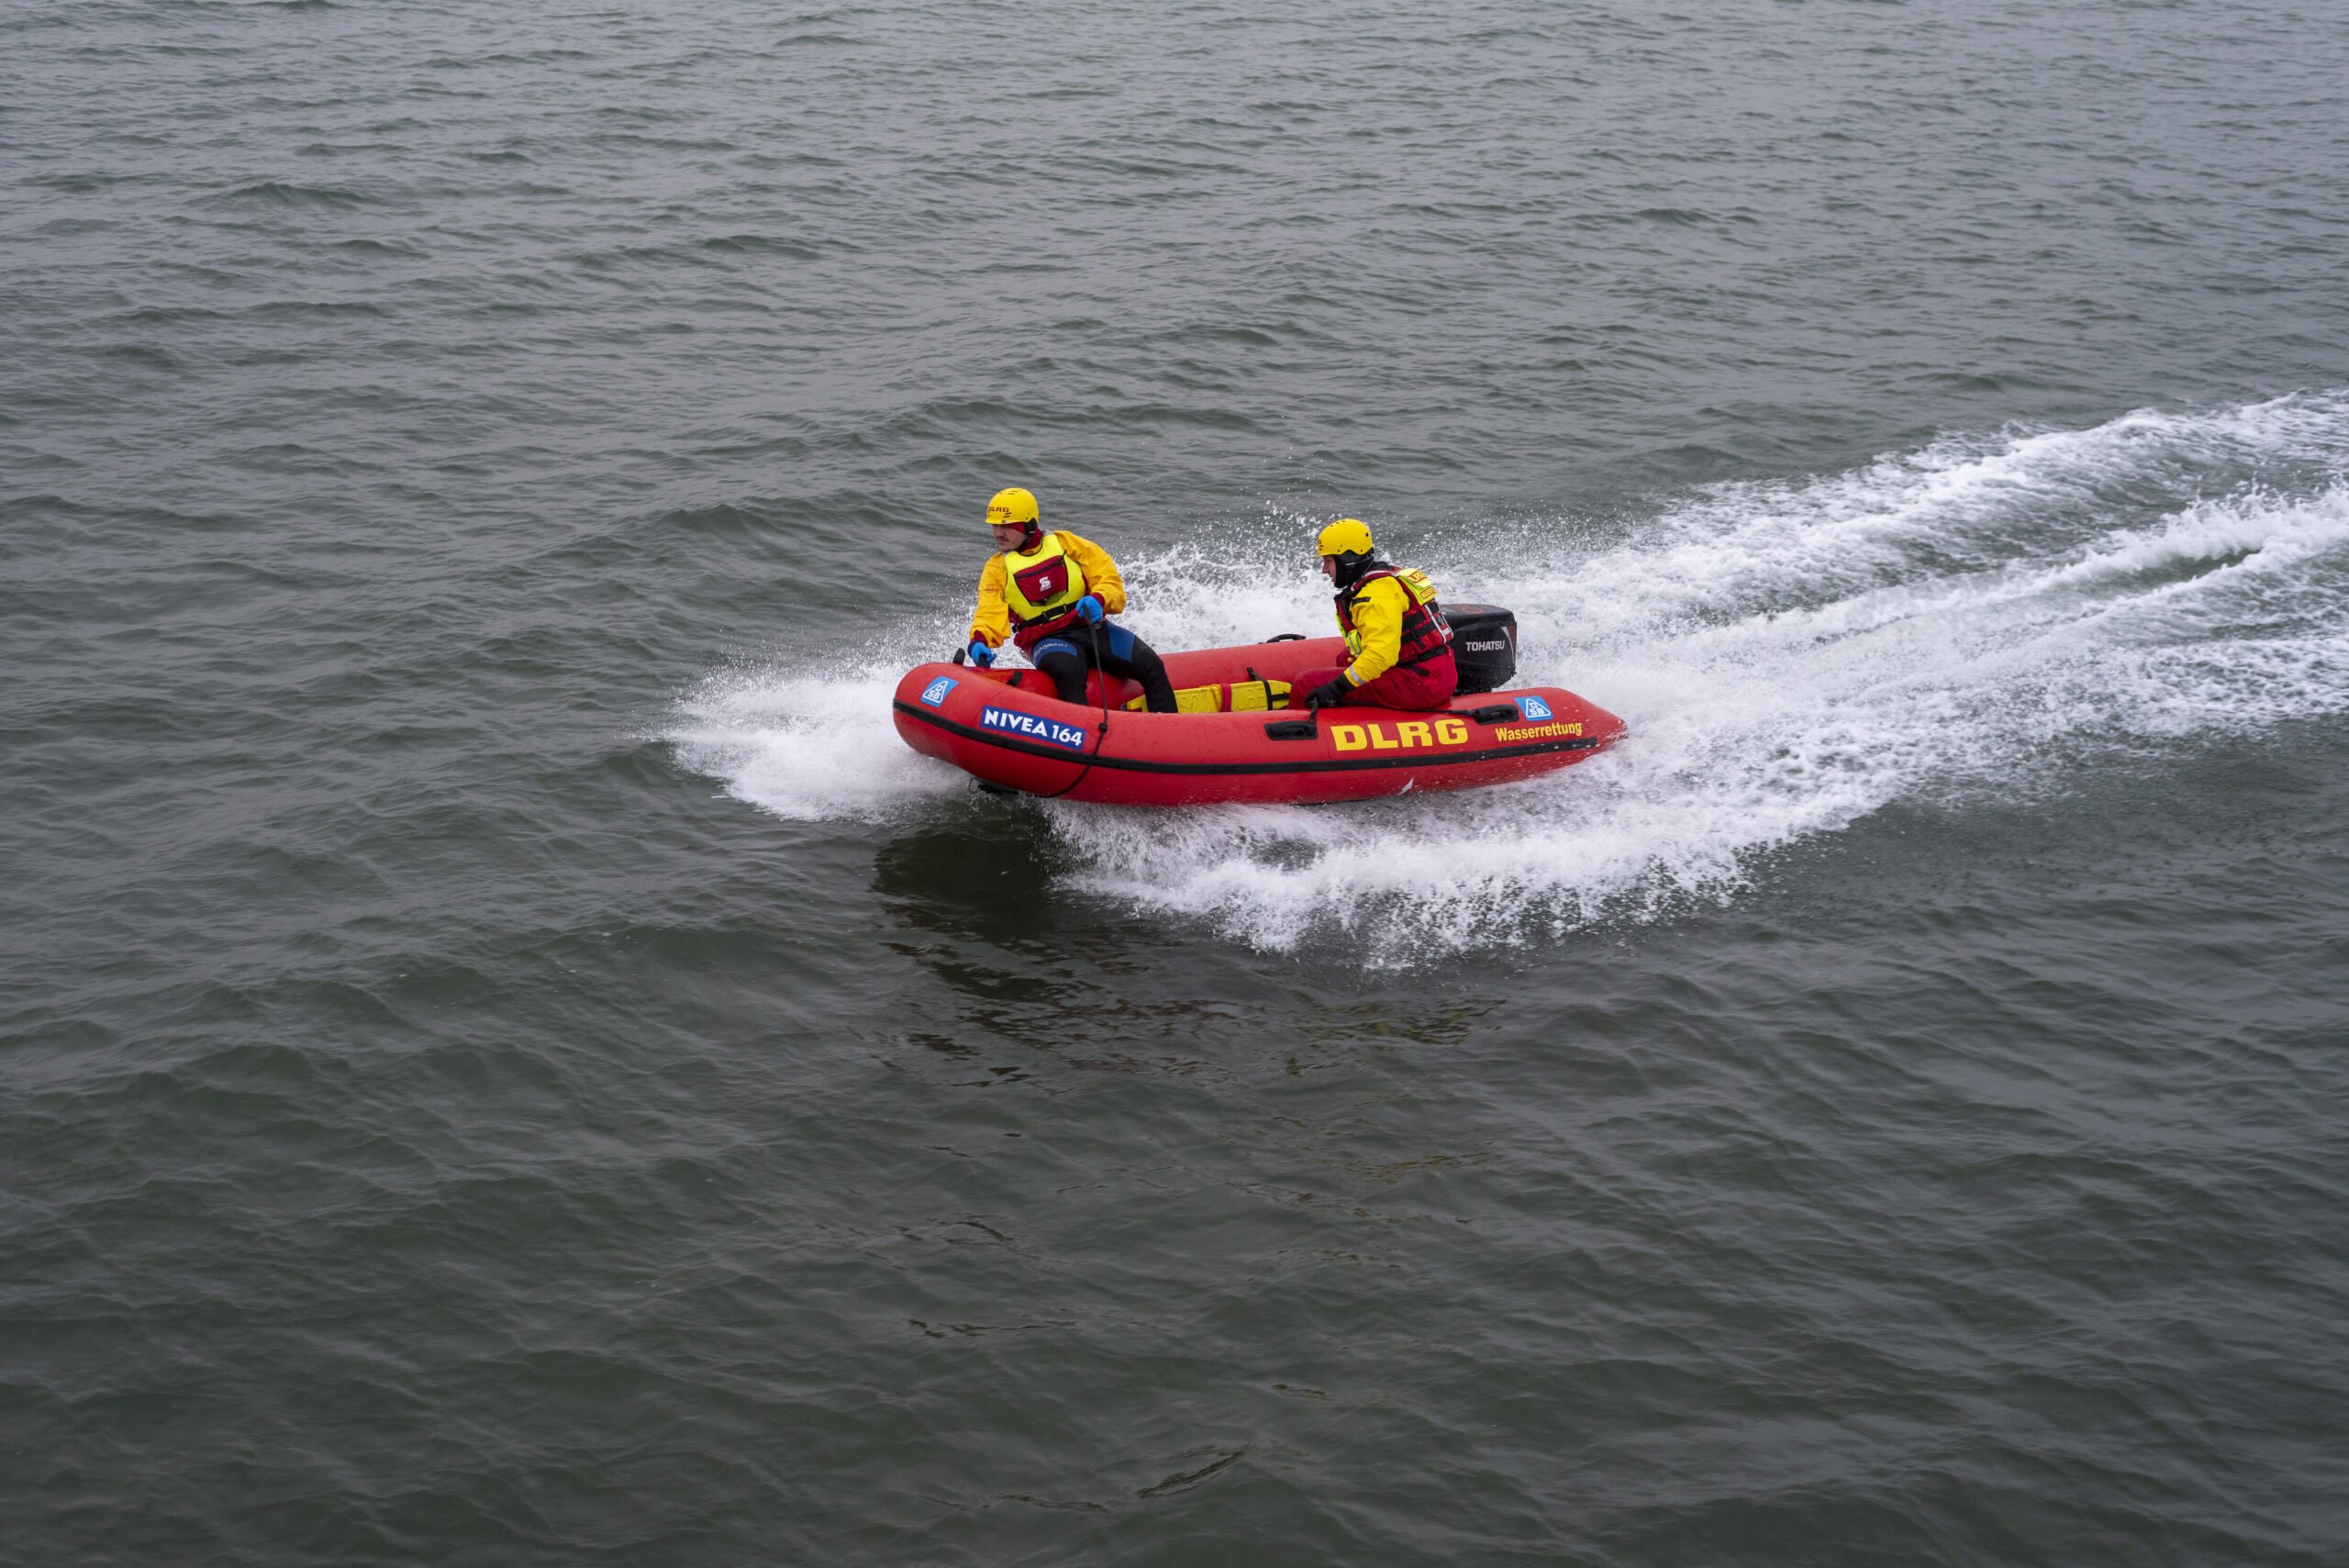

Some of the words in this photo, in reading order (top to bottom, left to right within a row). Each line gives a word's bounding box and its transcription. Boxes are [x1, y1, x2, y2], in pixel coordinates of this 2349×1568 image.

[1465, 640, 1505, 651] TOHATSU
[984, 708, 1048, 738] NIVEA
[1052, 725, 1083, 747] 164
[1330, 718, 1468, 751] DLRG
[1495, 722, 1583, 741] Wasserrettung
